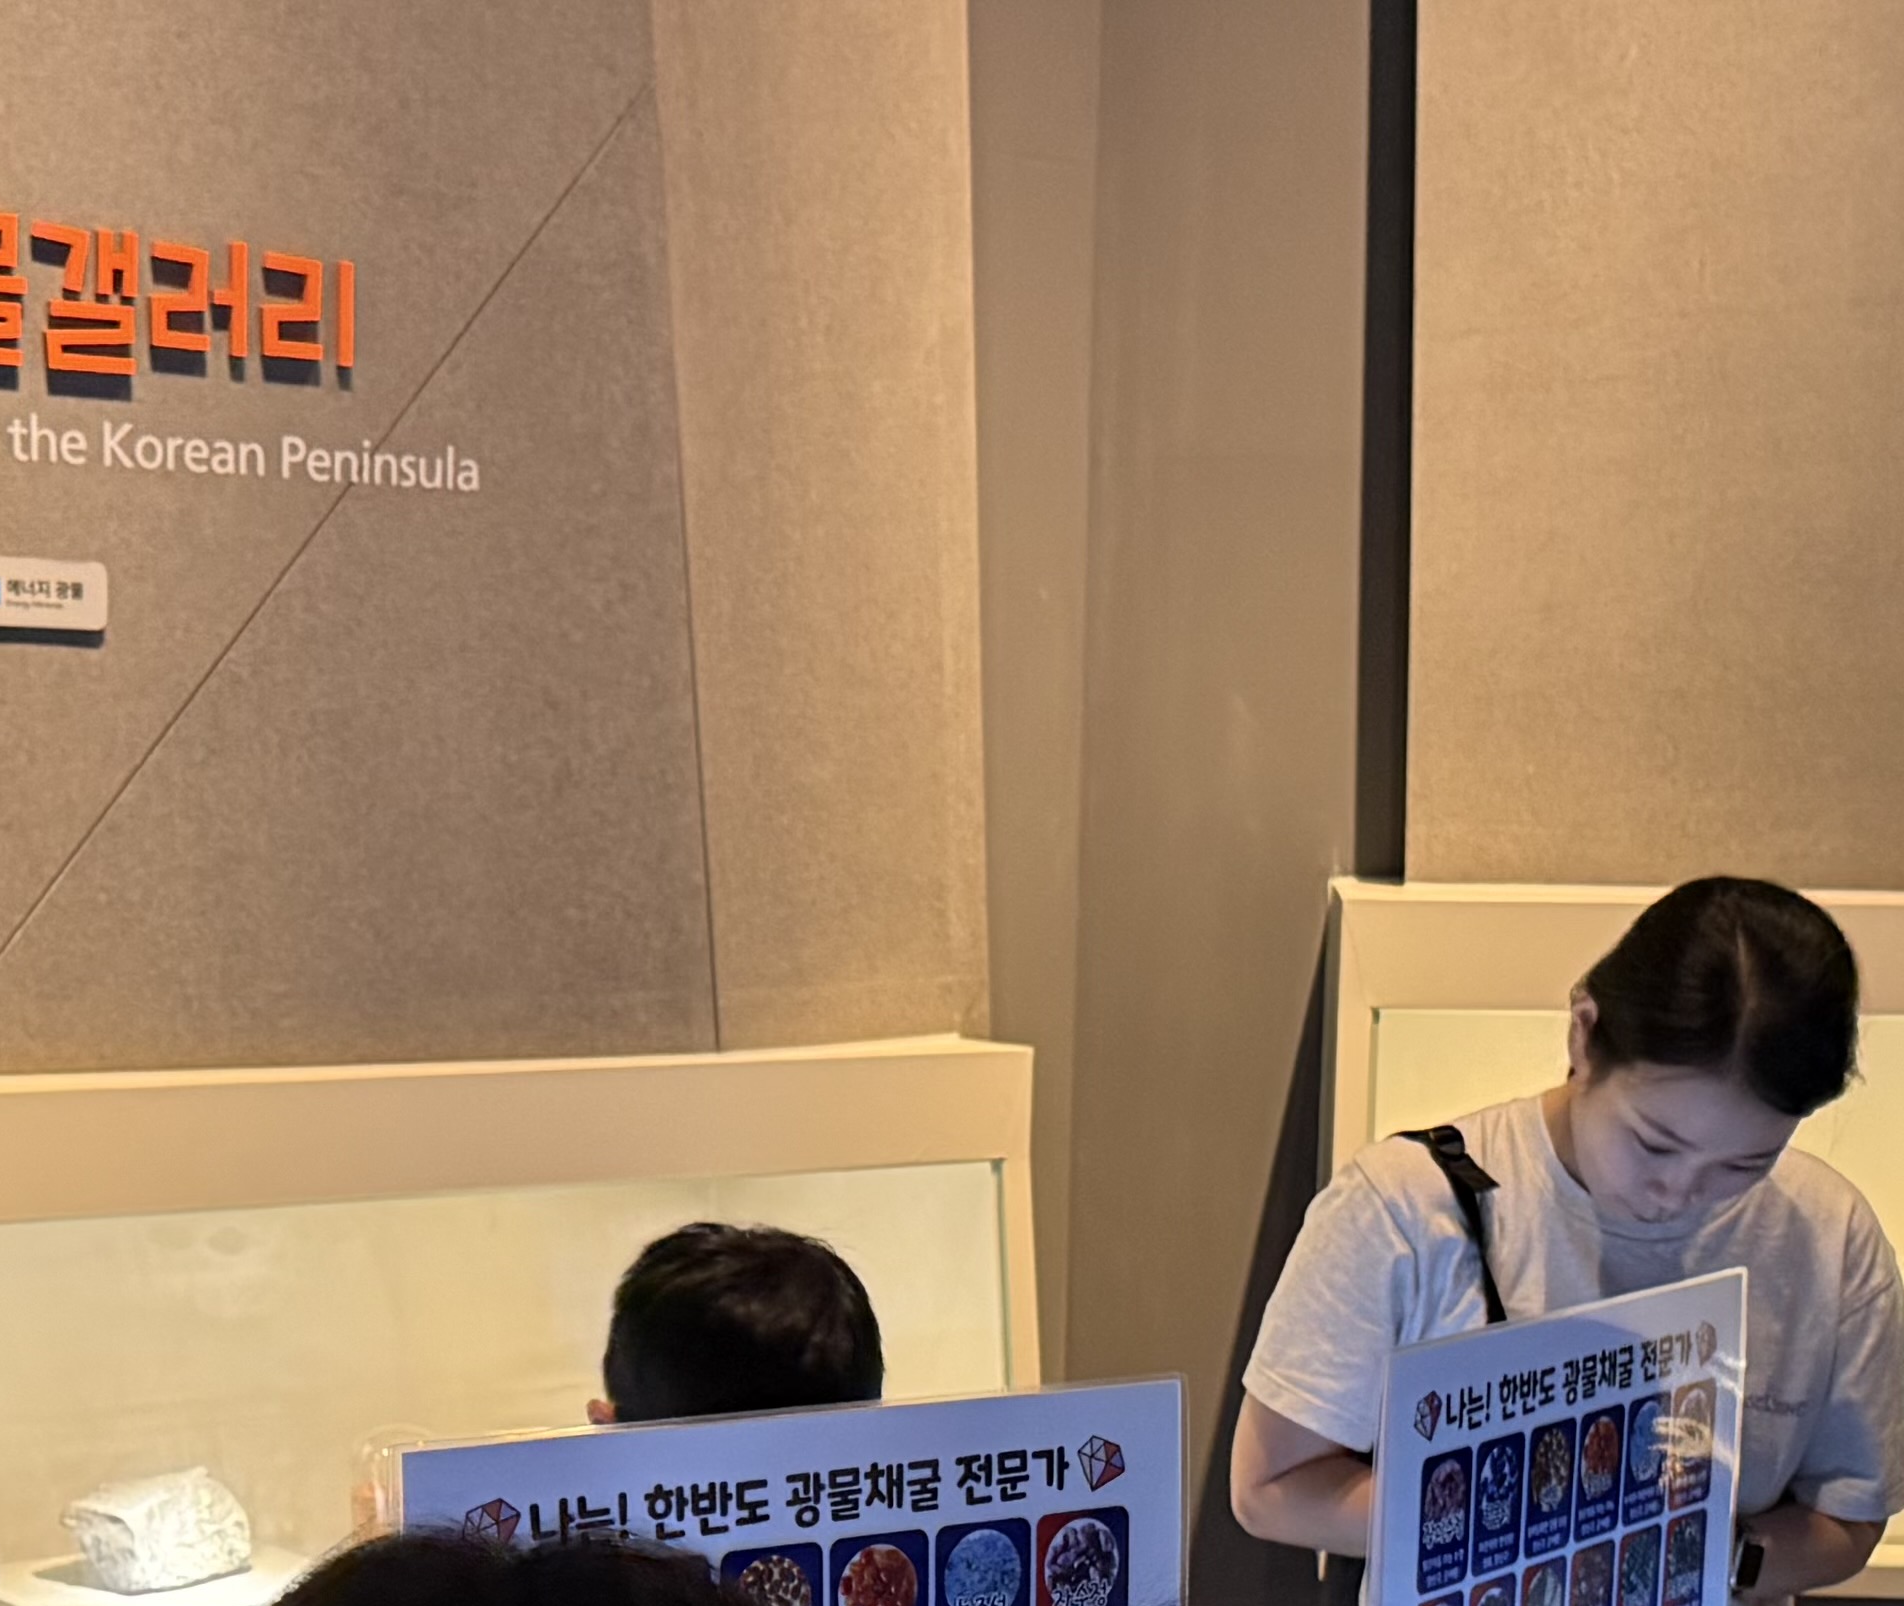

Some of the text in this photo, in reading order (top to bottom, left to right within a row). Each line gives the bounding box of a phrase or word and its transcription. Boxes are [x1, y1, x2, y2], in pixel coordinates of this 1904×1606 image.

[6, 413, 88, 466] the
[102, 420, 266, 478] Korean
[280, 435, 481, 493] Peninsula
[6, 579, 52, 600] 에너지
[1445, 1330, 1693, 1431] 나는! 한반도 광물채굴 전문가
[644, 1478, 771, 1541] 한반도
[784, 1458, 942, 1528] 광물채굴
[954, 1445, 1070, 1506] 전문가
